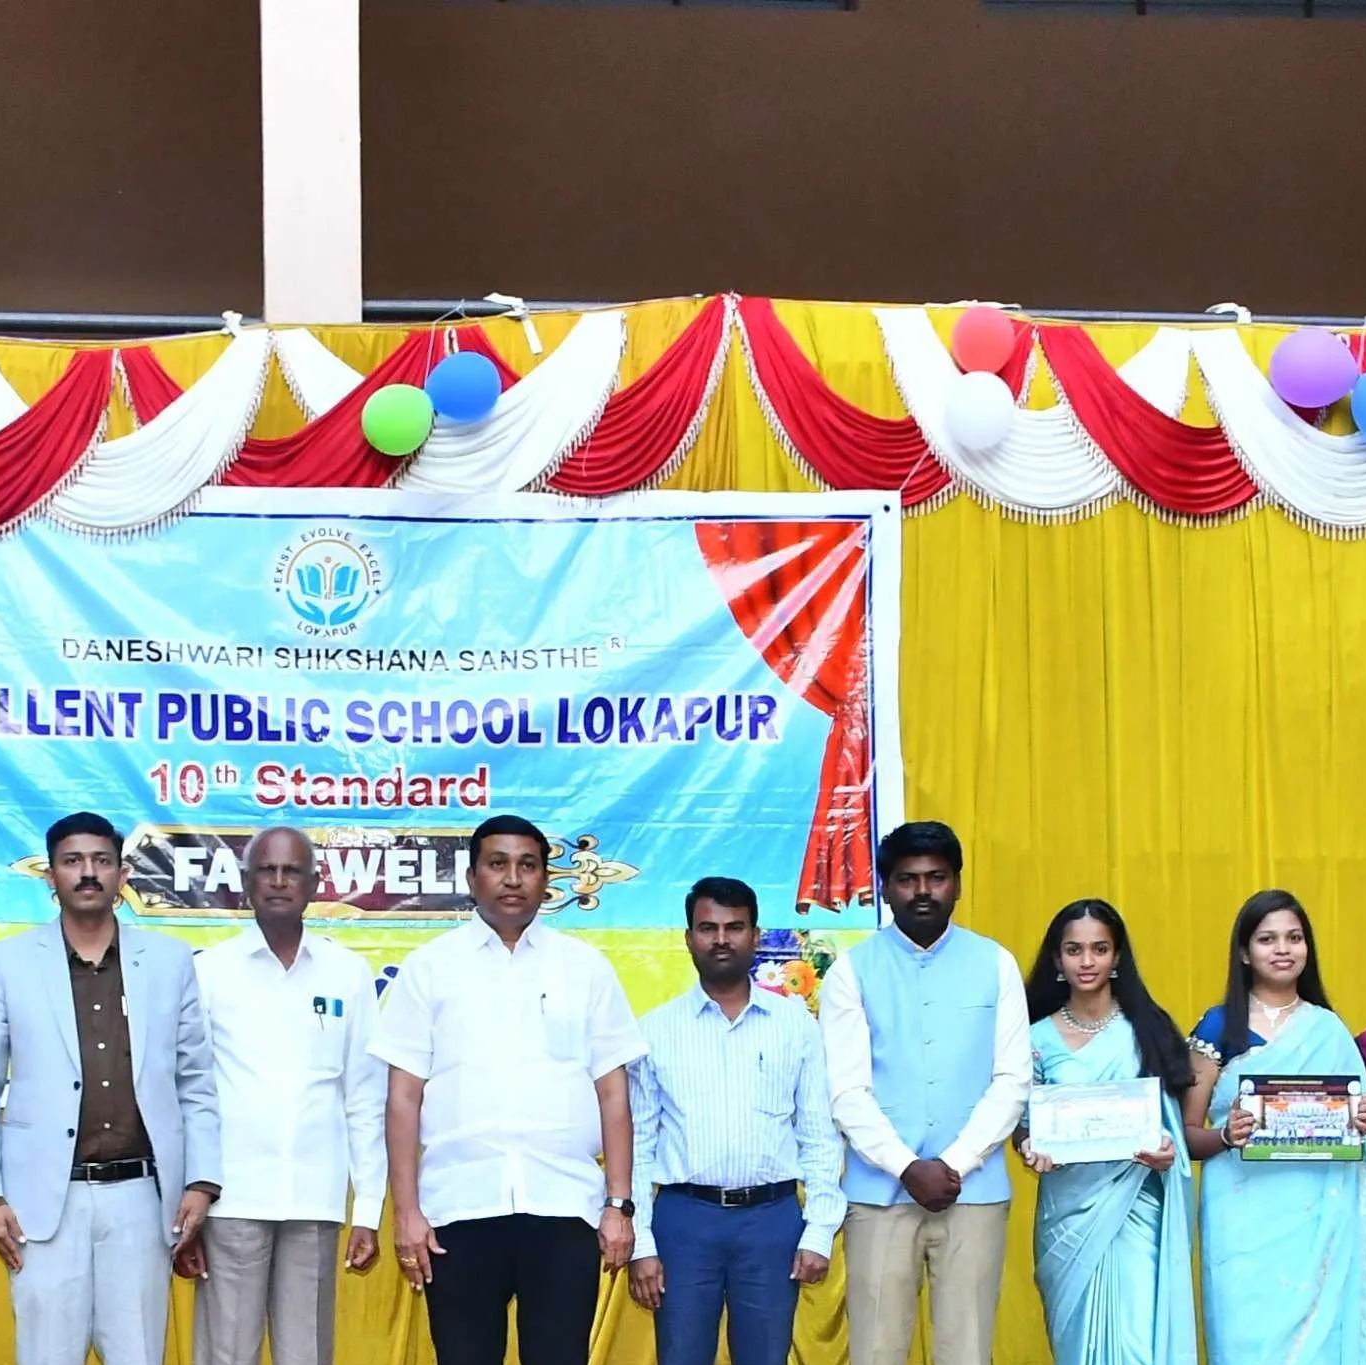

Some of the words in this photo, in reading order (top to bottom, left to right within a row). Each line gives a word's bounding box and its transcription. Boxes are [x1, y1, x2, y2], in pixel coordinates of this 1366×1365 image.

[274, 545, 294, 584] EXIST
[300, 527, 353, 543] EVOLVE
[359, 543, 381, 585] EXCEL
[62, 637, 262, 669] DANESHWARI
[274, 646, 450, 672] SHIKSHANA
[459, 646, 599, 672] SANSTHE
[157, 692, 331, 743] PUBLIC
[344, 697, 543, 745] SCHOOL
[556, 693, 779, 744] LOKAPUR
[255, 764, 487, 808] Standard
